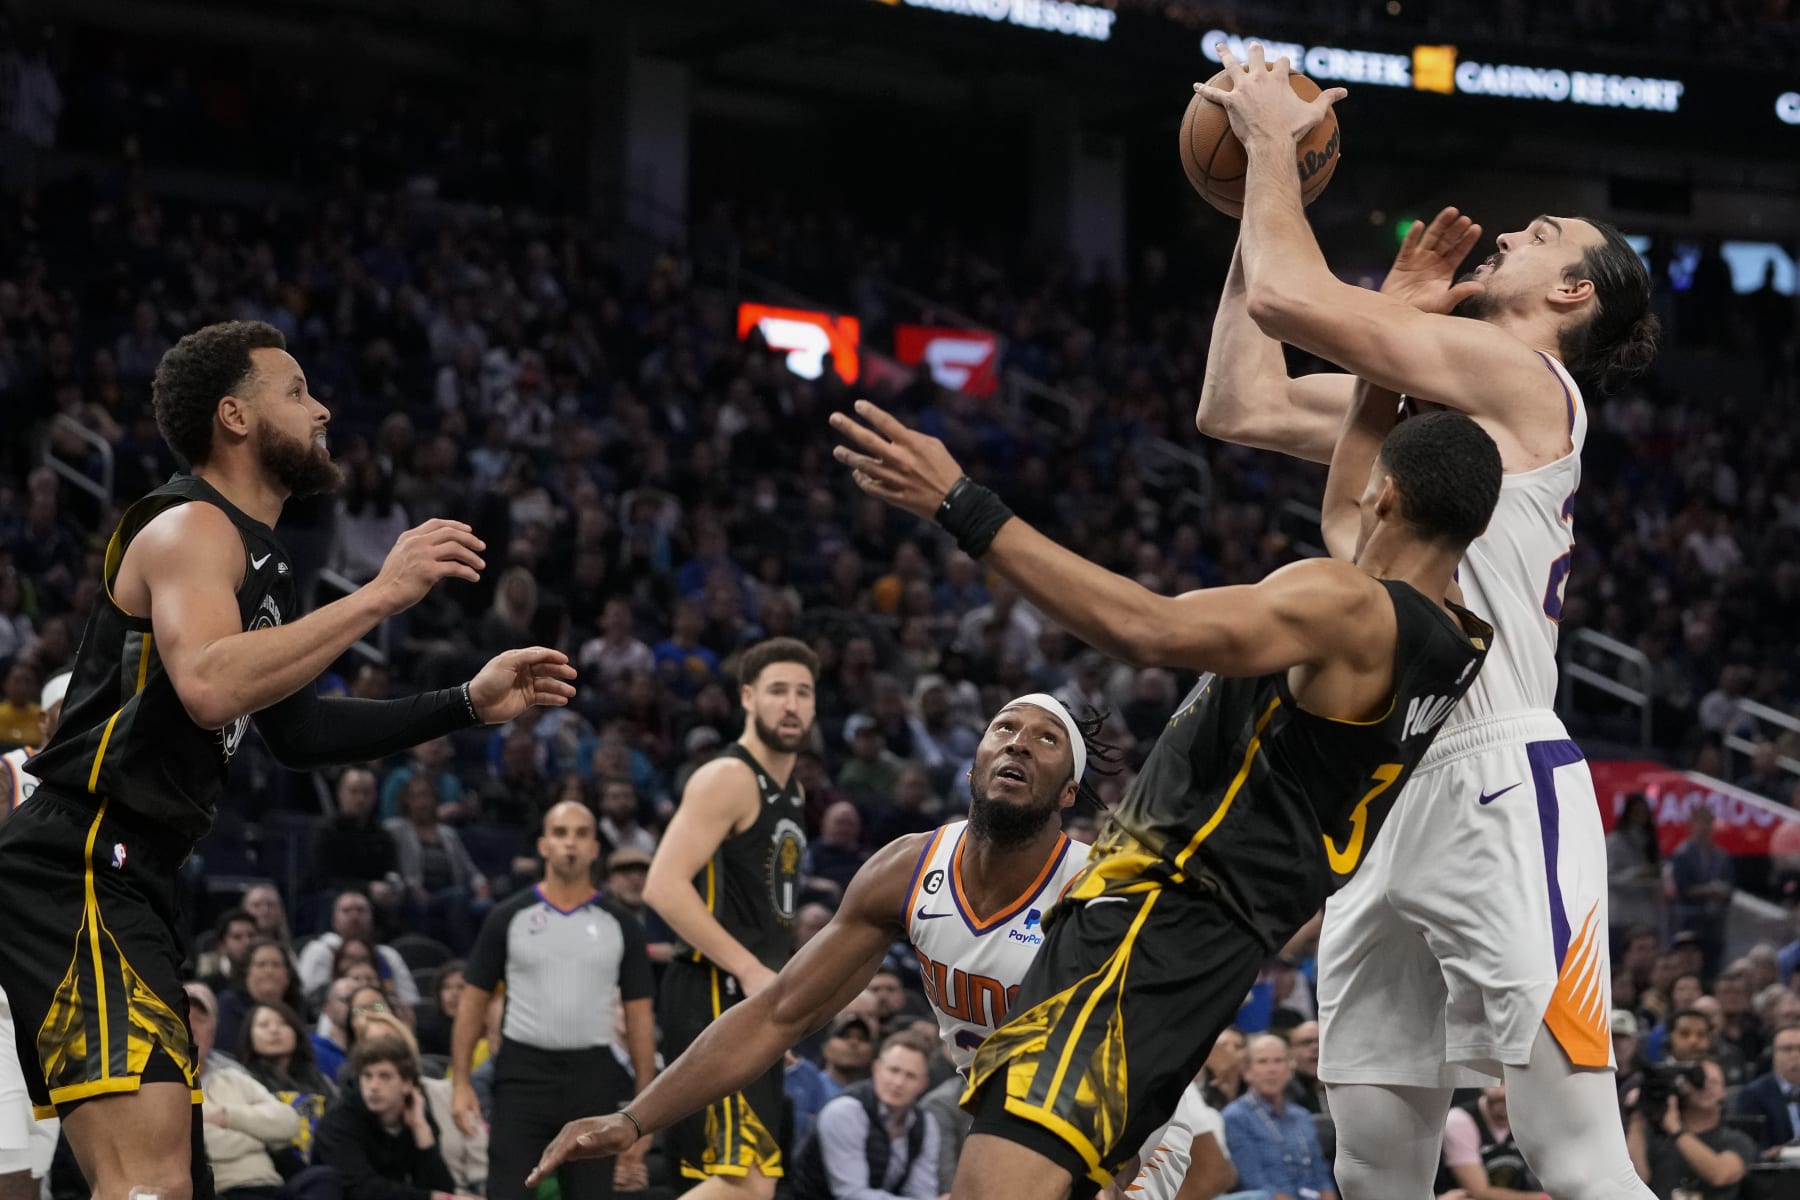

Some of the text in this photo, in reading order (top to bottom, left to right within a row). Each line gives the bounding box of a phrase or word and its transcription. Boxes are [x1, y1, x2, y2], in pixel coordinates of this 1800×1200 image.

[1008, 0, 1117, 41] RESORT
[1304, 46, 1413, 88] CREEK
[1455, 61, 1571, 101] CASINO
[1570, 71, 1684, 112] RESORT
[1296, 126, 1341, 182] ilson
[1322, 763, 1404, 875] 3
[924, 871, 944, 894] 6
[1008, 929, 1043, 945] PayPa
